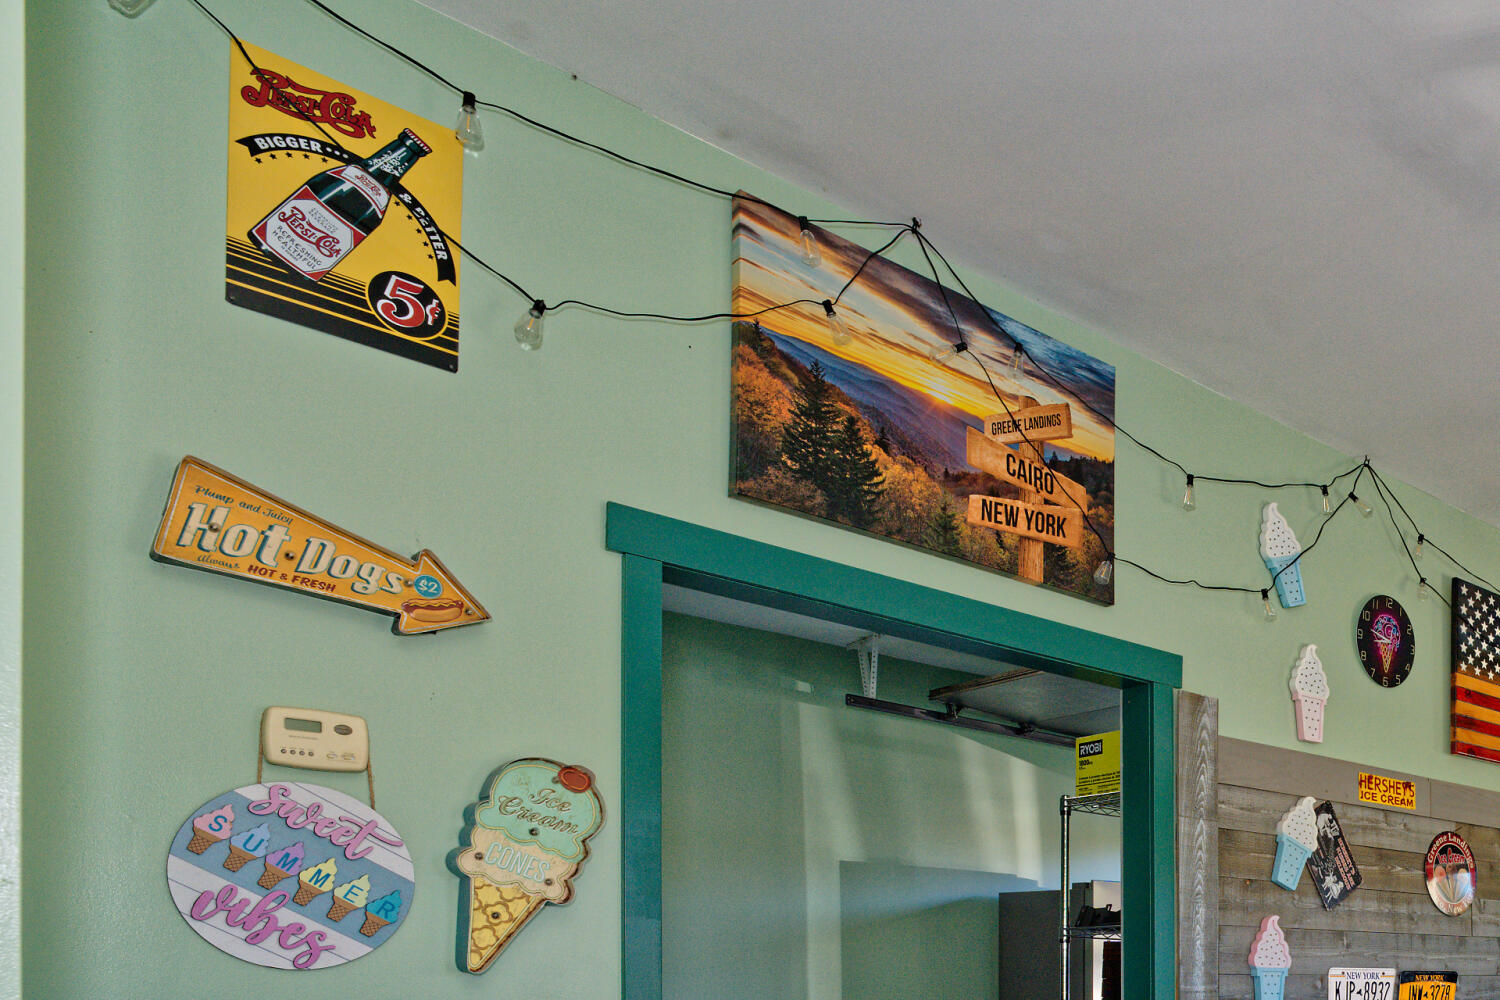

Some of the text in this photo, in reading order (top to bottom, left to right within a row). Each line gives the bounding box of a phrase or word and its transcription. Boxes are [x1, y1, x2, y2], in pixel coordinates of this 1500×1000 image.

[254, 135, 325, 155] BIGGER
[272, 230, 318, 269] HEALTHFUL
[277, 225, 322, 266] REFRESHING
[991, 413, 1062, 436] GREENE LANDINGS
[1006, 453, 1054, 495] CAIRO
[194, 485, 294, 526] Plump and Juicy
[981, 498, 1067, 539] NEW YORK
[177, 501, 404, 596] Hot Dogs
[247, 564, 277, 578] HOT
[279, 573, 287, 582] &
[290, 574, 337, 593] FRESH
[418, 578, 440, 594] $2
[1079, 741, 1102, 756] RYOBI
[498, 795, 579, 834] Cream
[527, 787, 573, 812] Ice
[1360, 790, 1414, 808] ICE CREAM
[247, 784, 403, 860] Sweet
[208, 815, 391, 919] SUMMER
[484, 841, 551, 882] CONES
[1427, 833, 1447, 864] Greene
[190, 883, 335, 969] vibes
[1346, 971, 1380, 980] NEW YORK
[1415, 974, 1445, 982] NEW YORK
